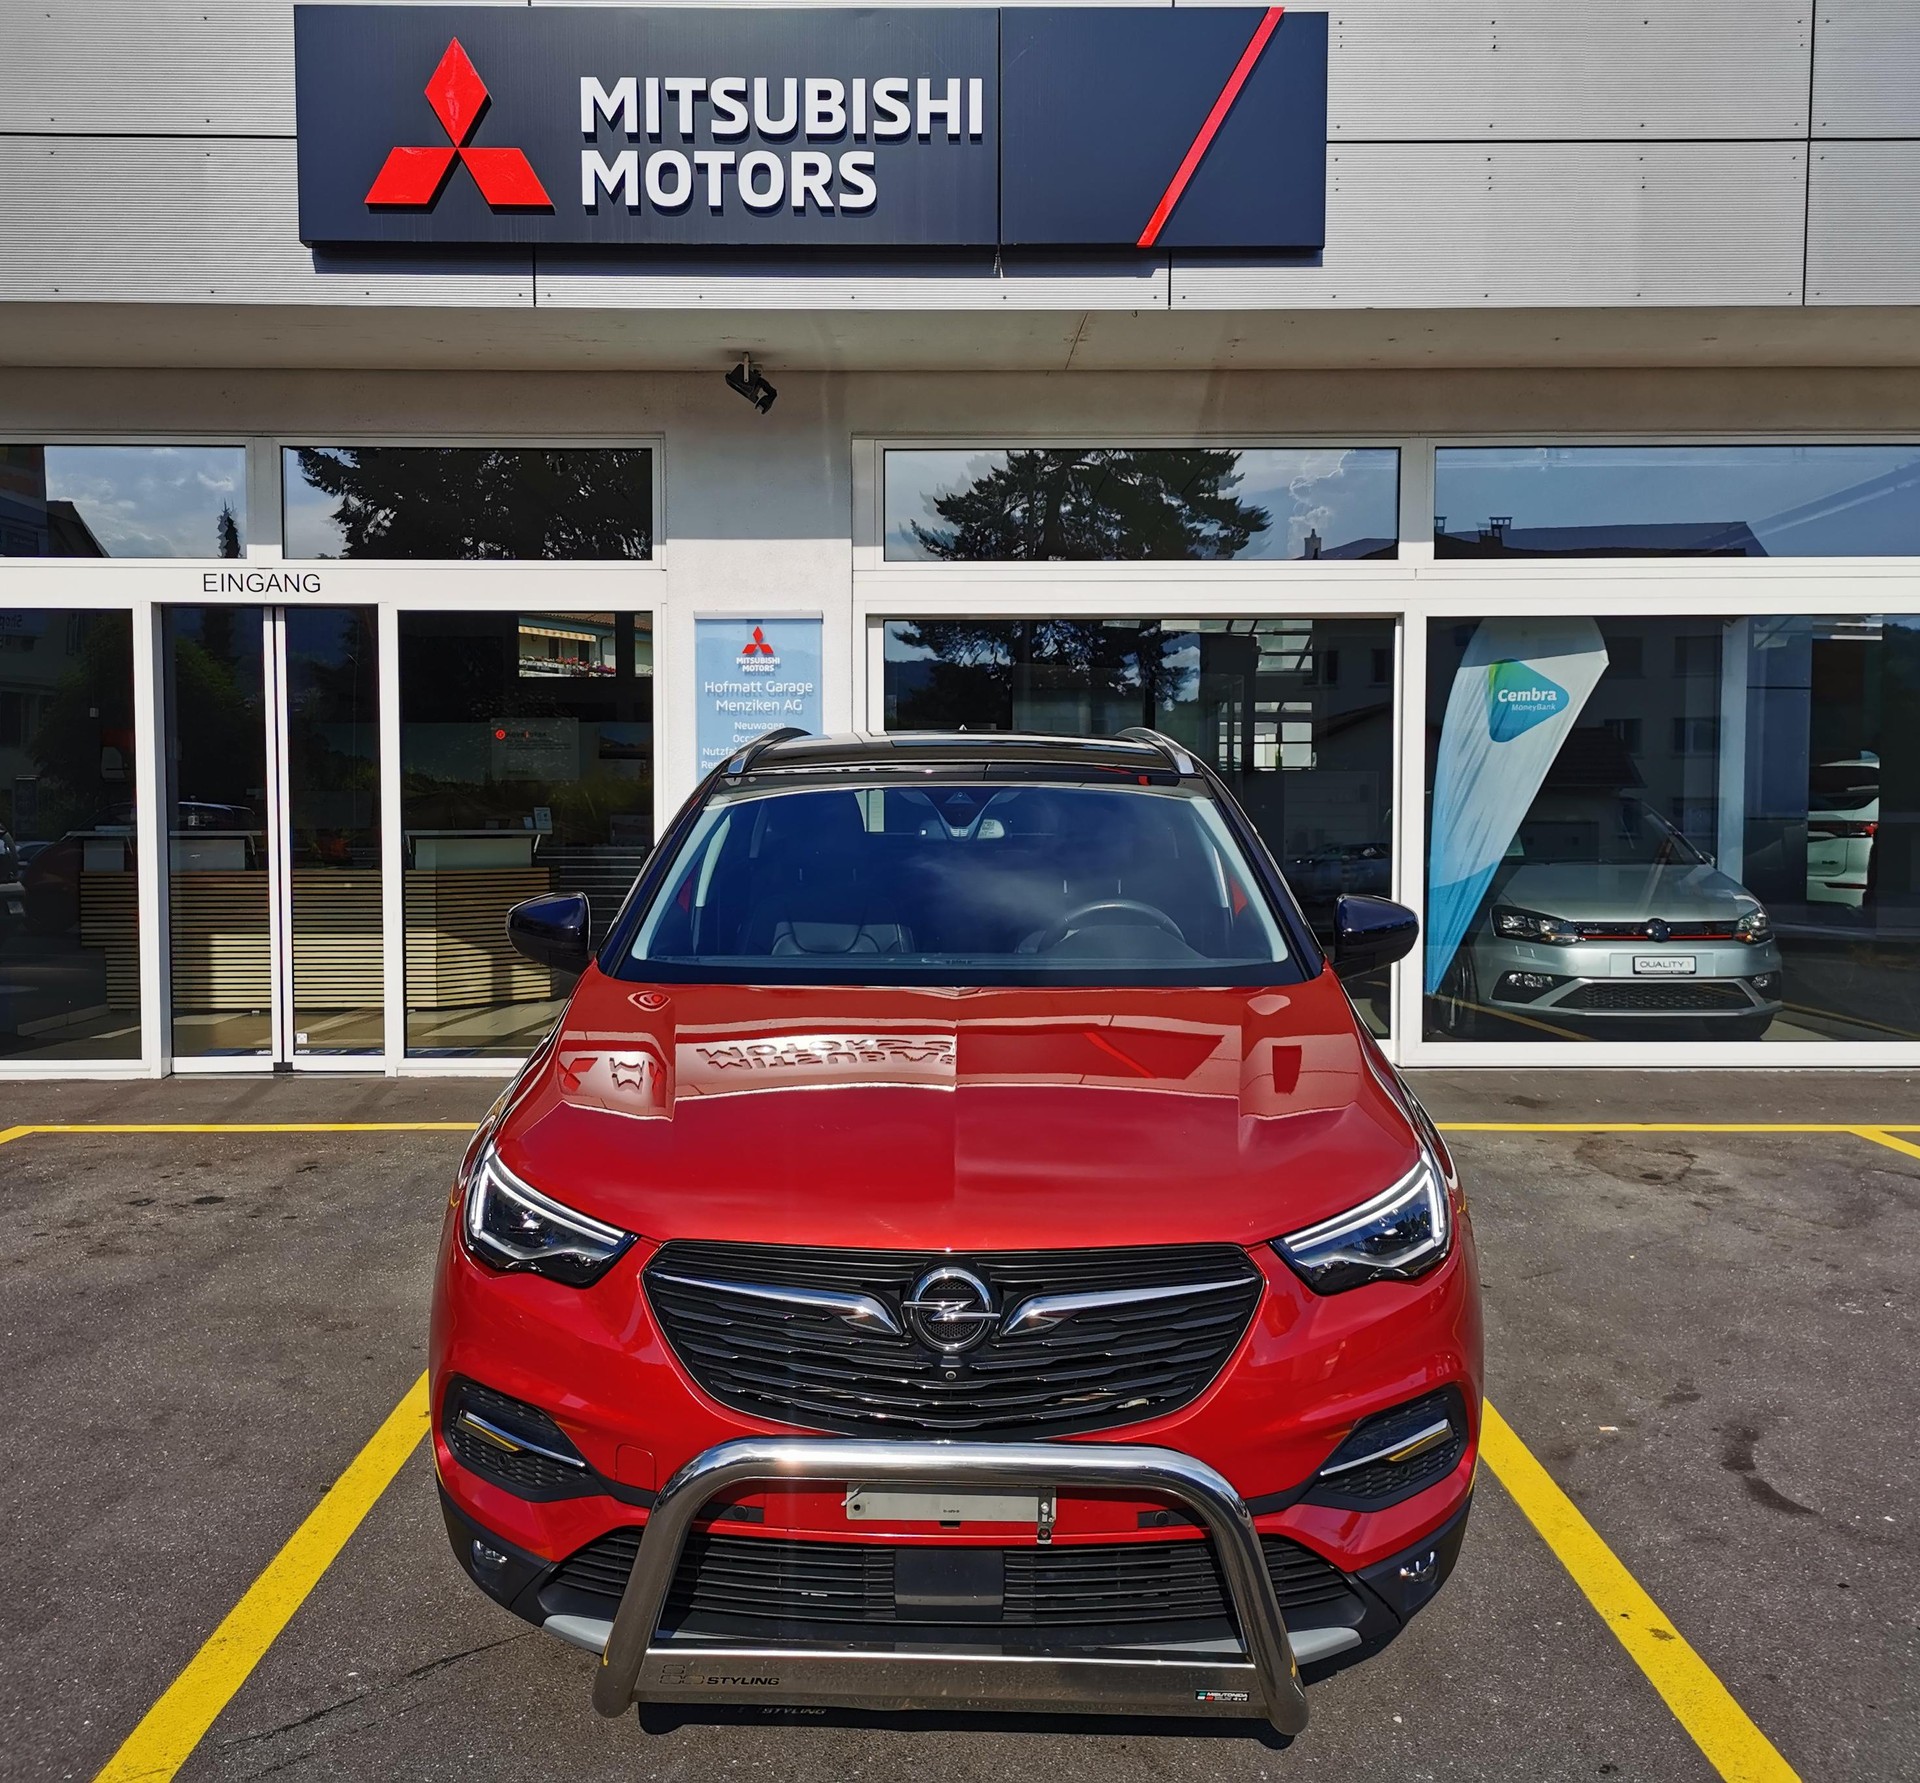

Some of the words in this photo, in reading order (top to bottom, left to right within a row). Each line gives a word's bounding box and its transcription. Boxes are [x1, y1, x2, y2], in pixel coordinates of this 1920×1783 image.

[580, 76, 983, 135] MITSUBISHI
[580, 149, 878, 208] MOTORS
[203, 573, 321, 593] EINGANG
[704, 681, 762, 693] Hofmatt
[766, 681, 813, 694] Garage
[1498, 687, 1557, 702] Cembra
[716, 700, 780, 711] Menziken
[784, 700, 802, 711] AG
[1512, 703, 1556, 711] MoneyBank
[707, 1677, 780, 1685] STYLING
